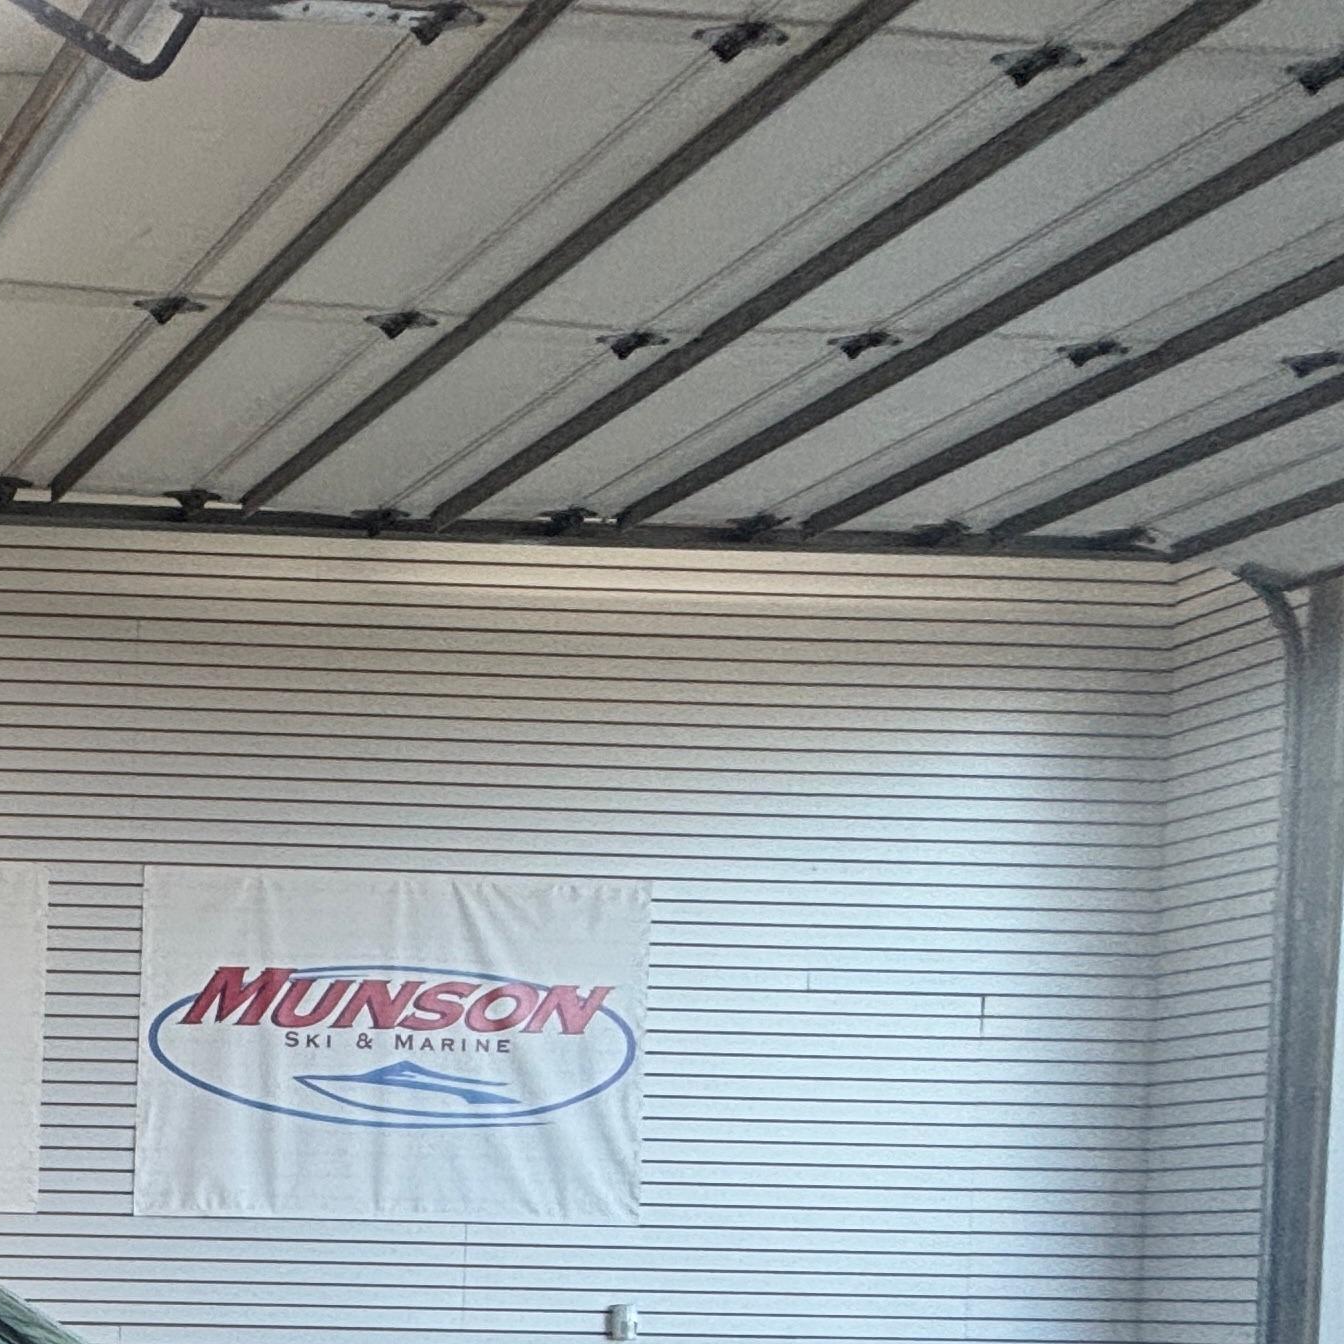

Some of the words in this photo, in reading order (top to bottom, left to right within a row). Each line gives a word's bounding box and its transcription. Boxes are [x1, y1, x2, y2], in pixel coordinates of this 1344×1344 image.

[175, 965, 616, 1035] MUNSON
[285, 1031, 332, 1049] SKI
[356, 1032, 373, 1050] &
[394, 1034, 511, 1054] MARINE
